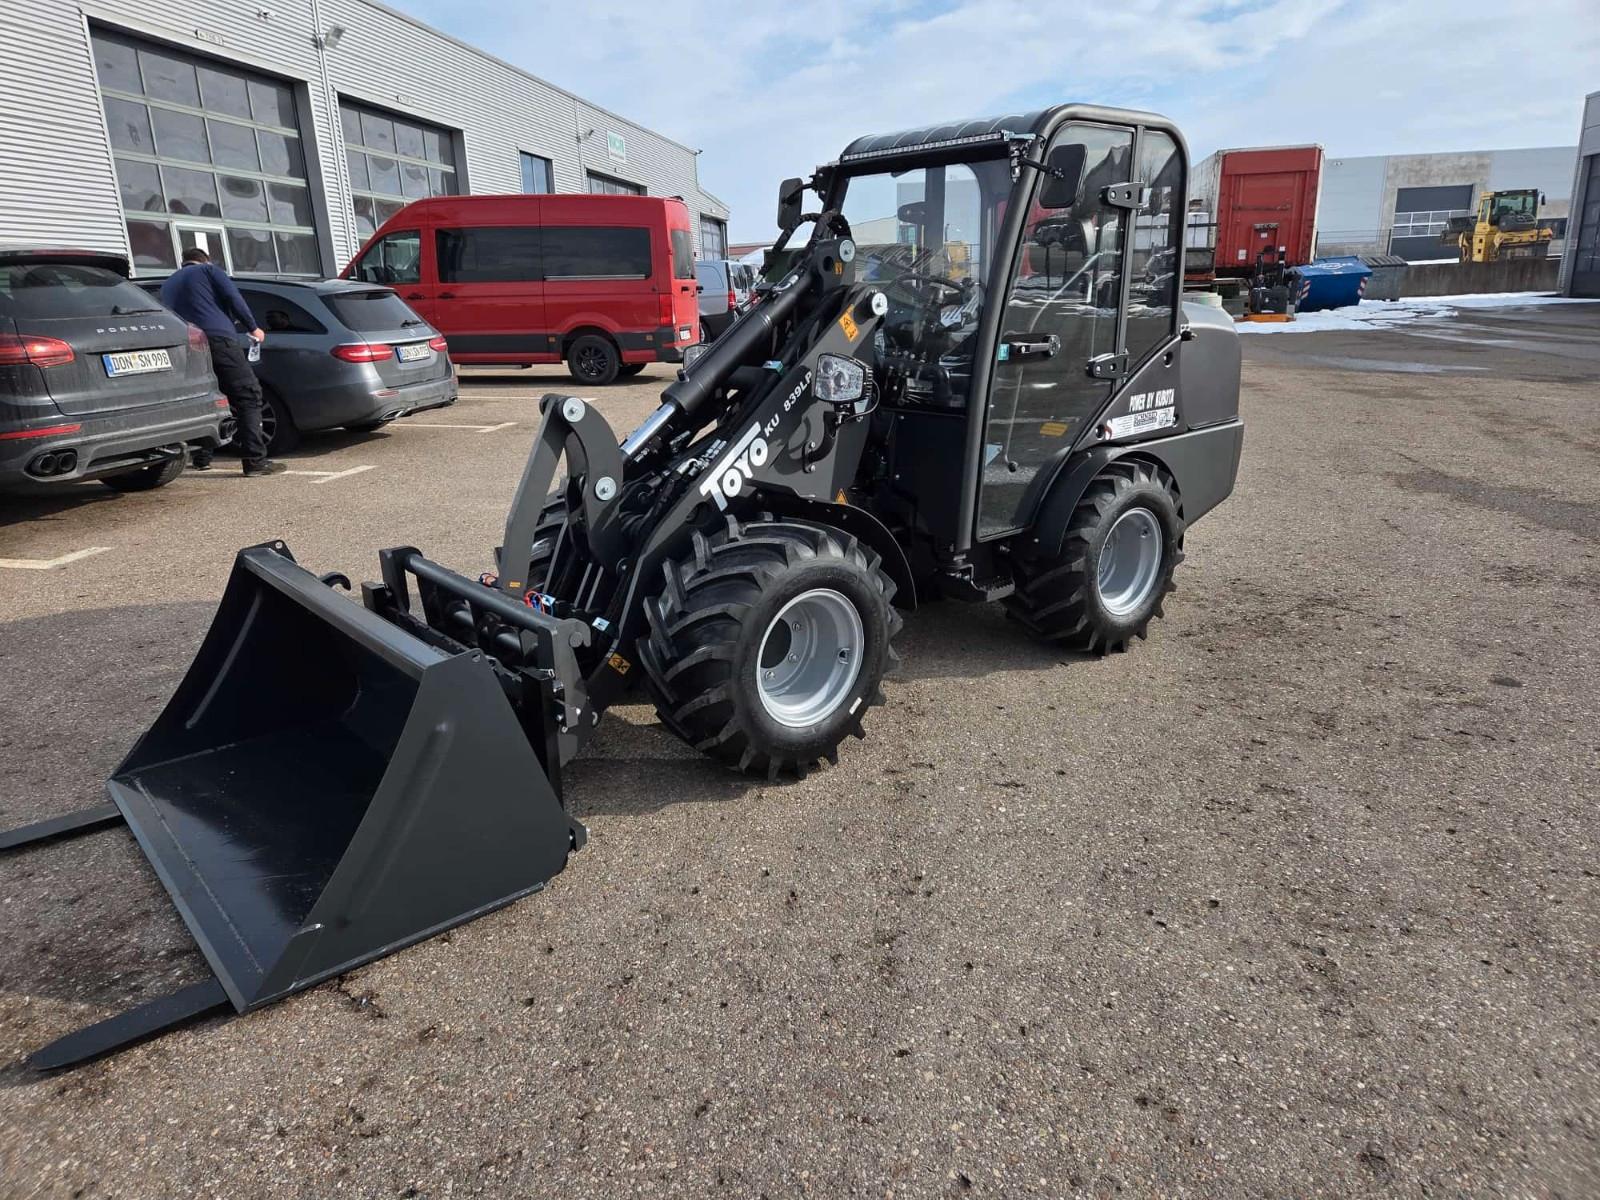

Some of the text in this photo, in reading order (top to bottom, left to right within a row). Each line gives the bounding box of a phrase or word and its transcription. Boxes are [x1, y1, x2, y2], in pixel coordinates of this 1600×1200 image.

[96, 324, 166, 333] PORSCHE
[112, 352, 169, 370] DON SN 998
[1129, 389, 1175, 412] POWER BY KUBOTA
[700, 371, 812, 511] TOYO KU 839LP
